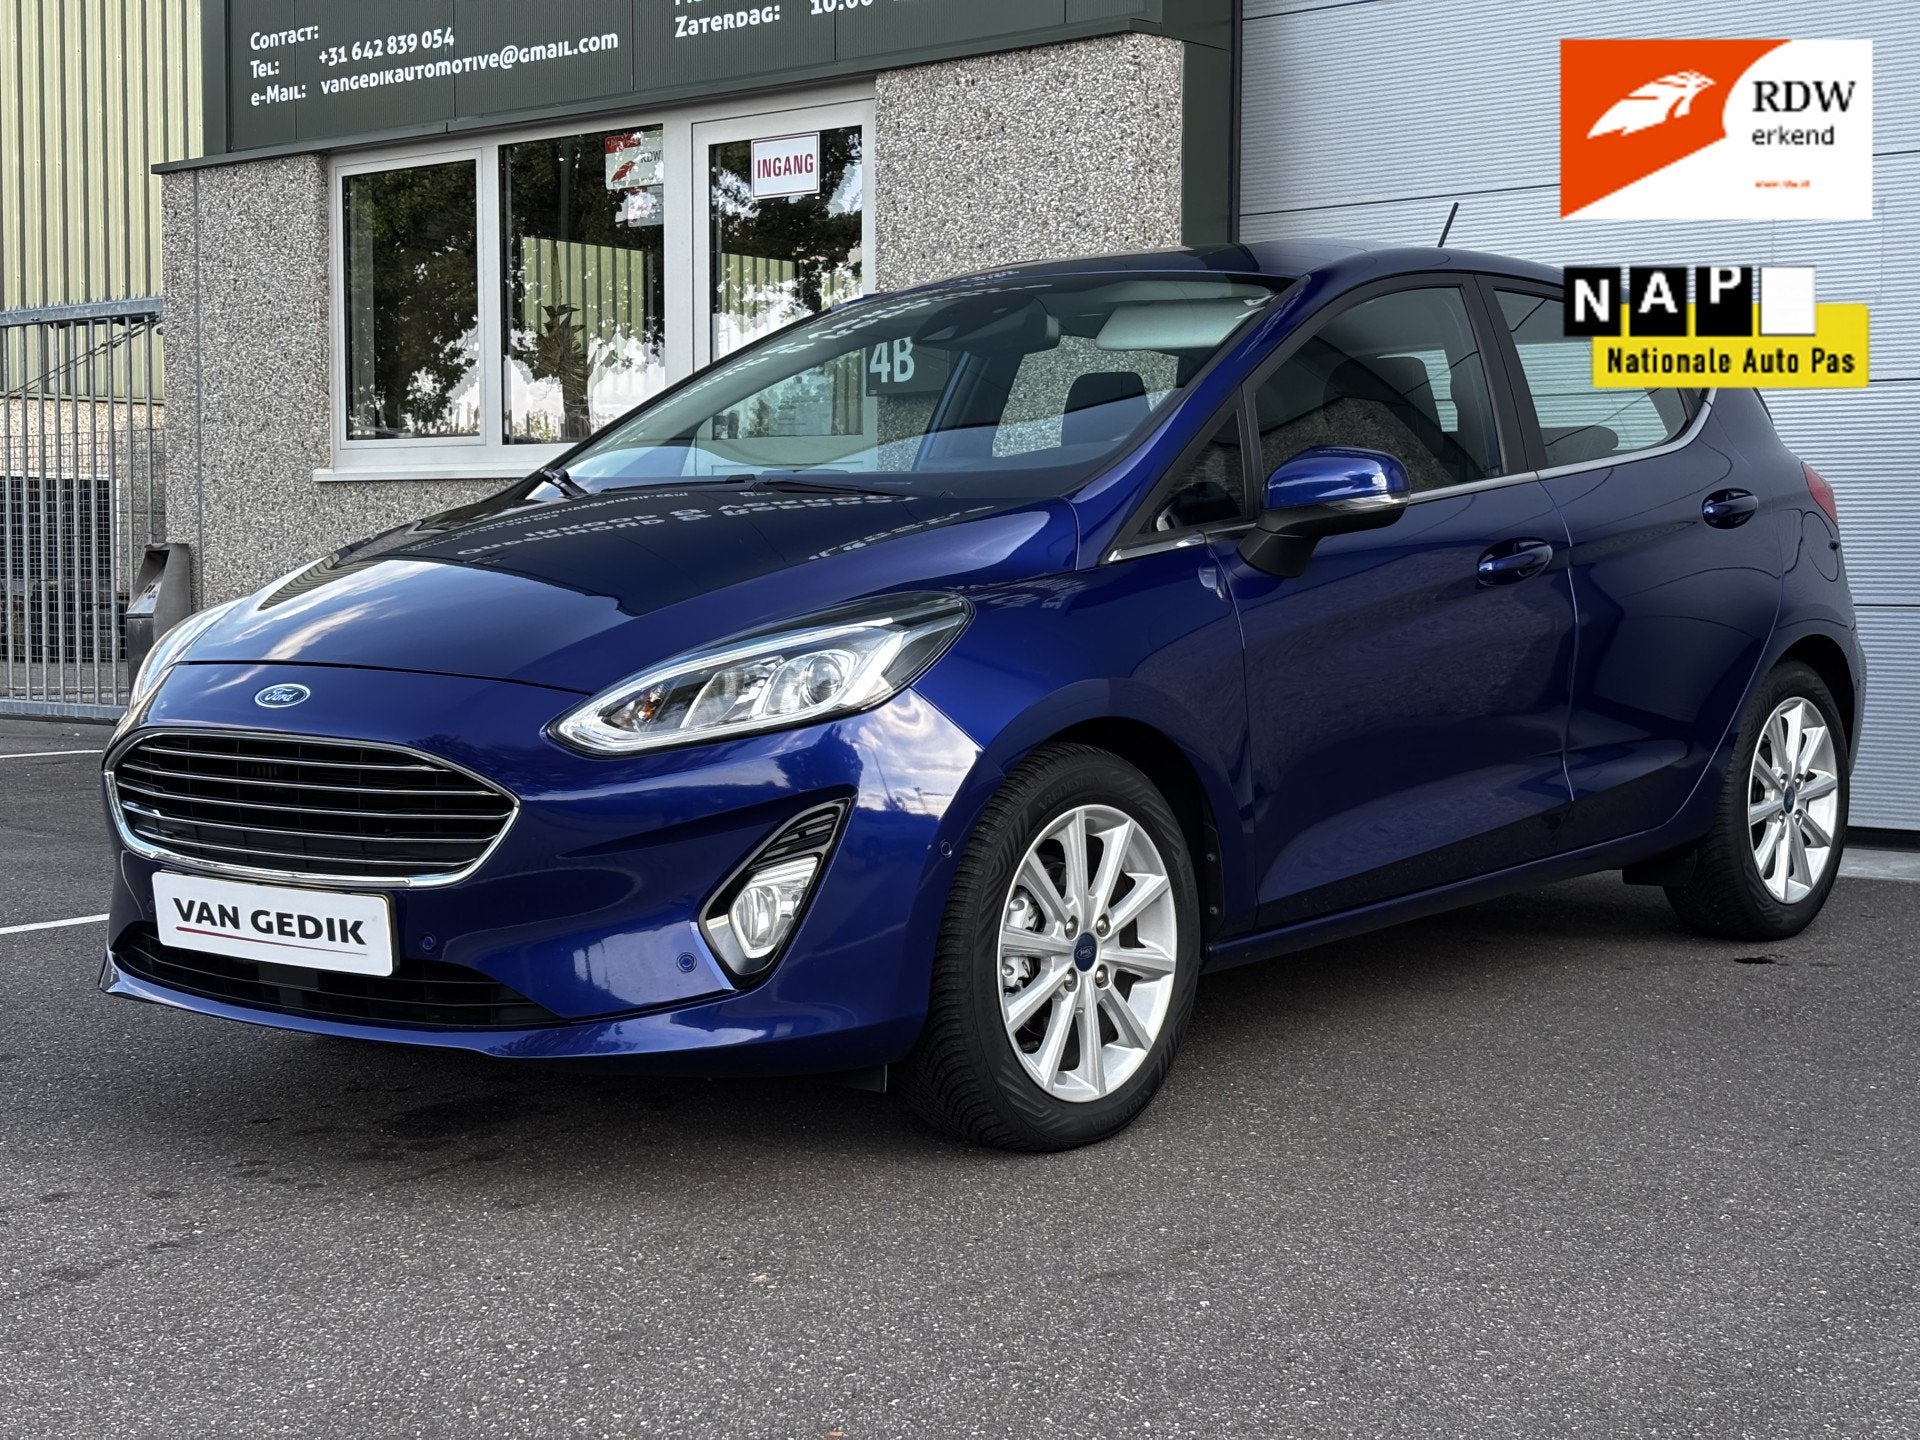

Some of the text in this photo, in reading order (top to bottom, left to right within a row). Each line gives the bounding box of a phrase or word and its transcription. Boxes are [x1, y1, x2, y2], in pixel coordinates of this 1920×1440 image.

[250, 25, 319, 50] Contact:
[674, 5, 780, 38] Zaterdag:
[250, 27, 455, 79] Tel: +31 642 839 054
[250, 32, 619, 106] e-Mail: vangedikautomotive@gmail.com
[757, 153, 814, 179] INGANG
[869, 336, 915, 383] 4B
[265, 687, 299, 702] Ford
[172, 897, 367, 946] VAN GEDIK
